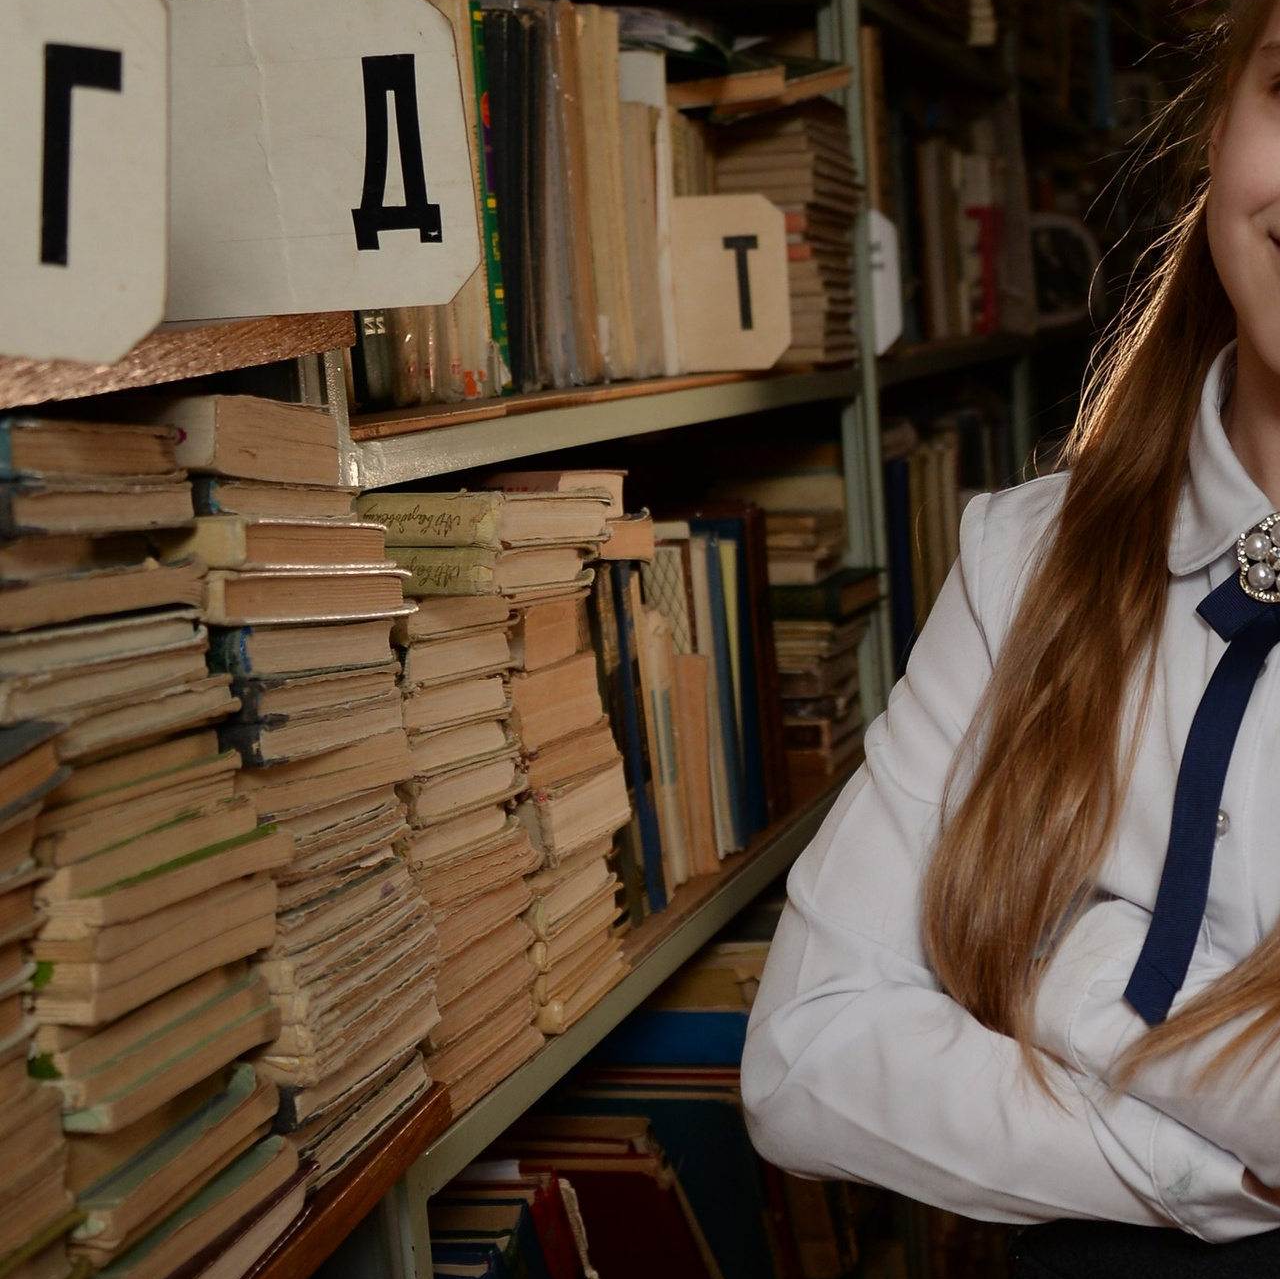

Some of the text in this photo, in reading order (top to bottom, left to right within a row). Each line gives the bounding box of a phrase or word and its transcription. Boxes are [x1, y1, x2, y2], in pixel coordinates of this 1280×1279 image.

[42, 43, 121, 265] Г
[351, 53, 443, 252] Д
[724, 234, 758, 330] Т
